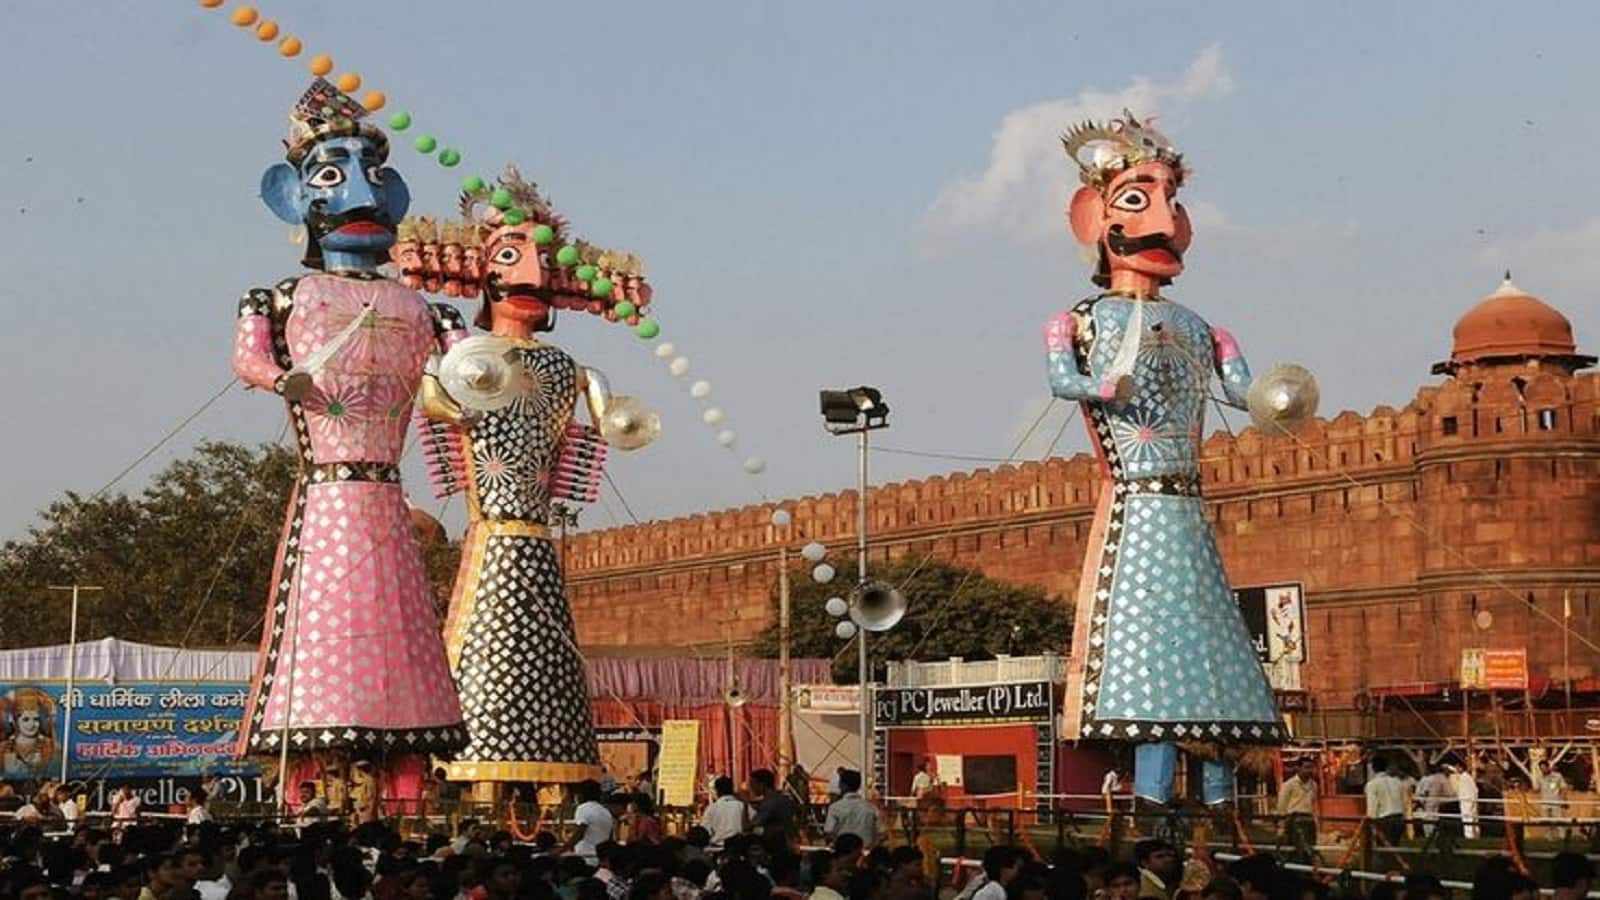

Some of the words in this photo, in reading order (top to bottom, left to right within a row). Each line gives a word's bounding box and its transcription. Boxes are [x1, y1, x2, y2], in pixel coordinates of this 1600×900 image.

[90, 687, 150, 708] धार्मिक
[160, 687, 205, 708] लीला
[901, 690, 925, 713] PC
[925, 689, 984, 718] Jeweller
[986, 686, 1011, 714] (P)
[1014, 683, 1049, 709] Ltd.
